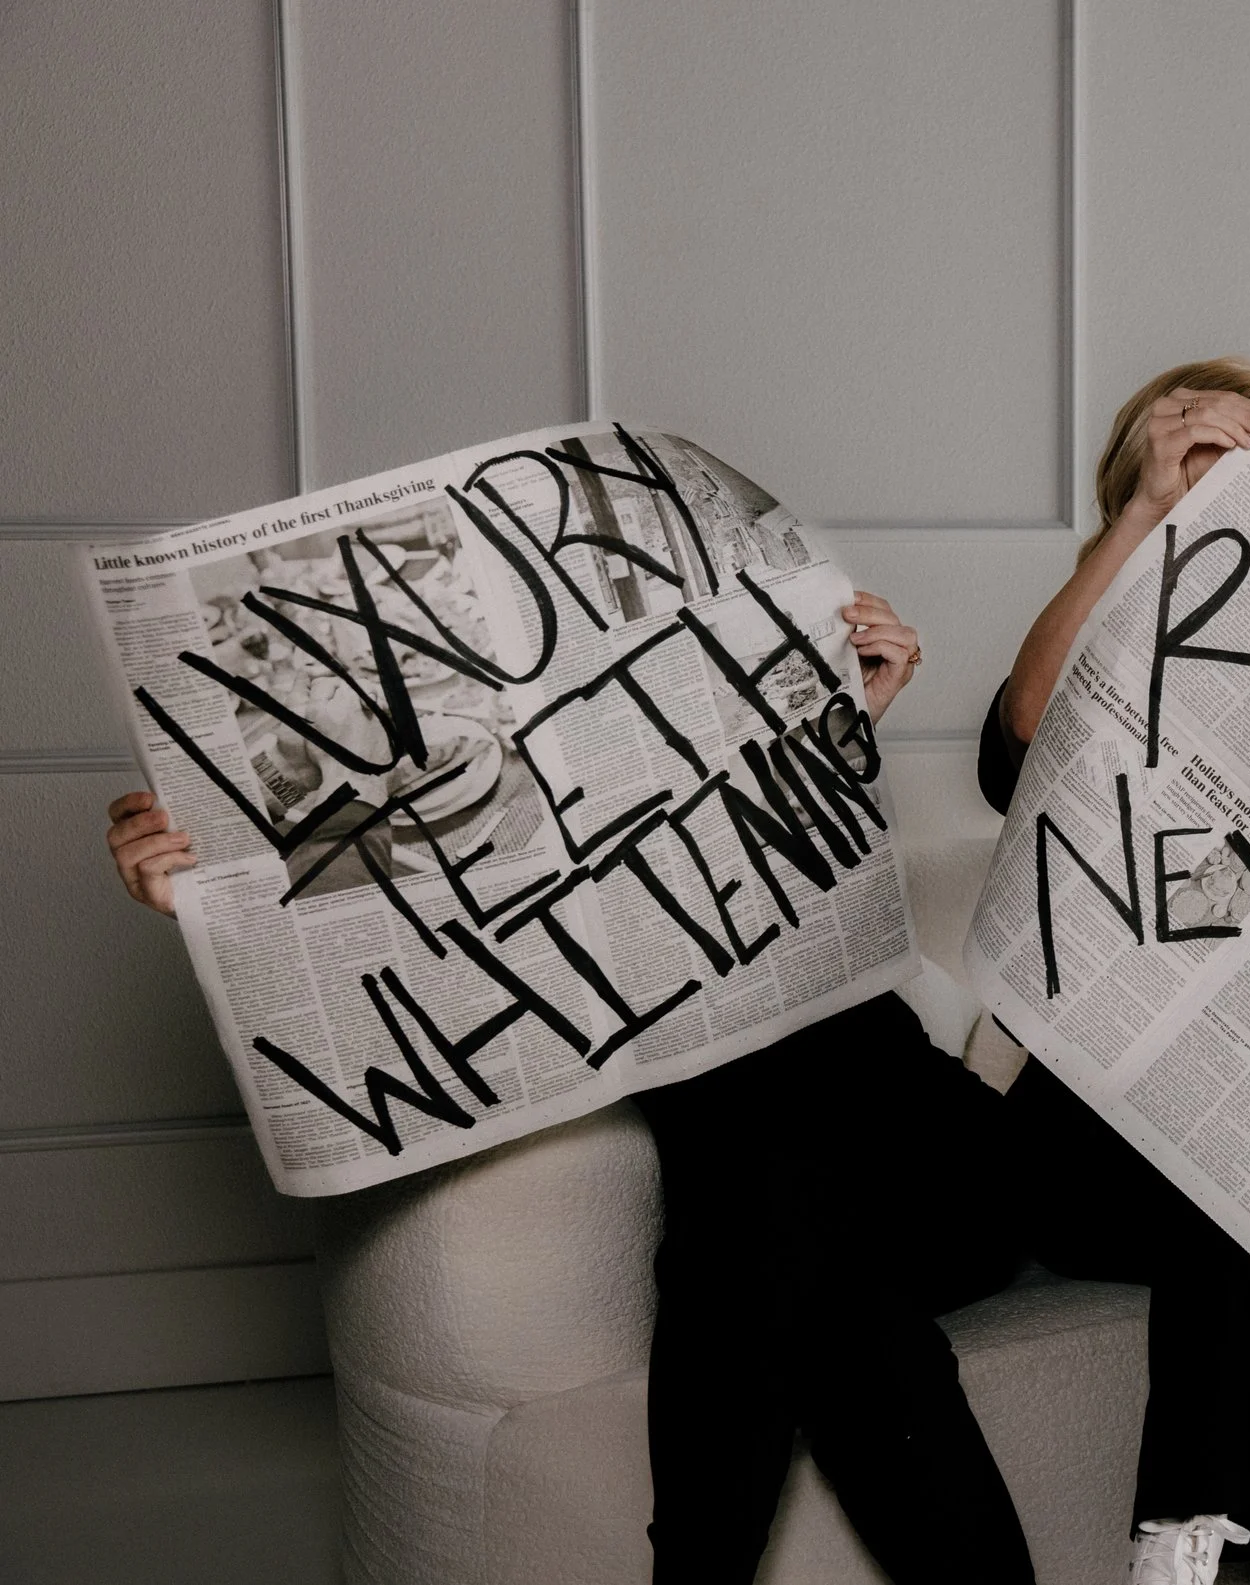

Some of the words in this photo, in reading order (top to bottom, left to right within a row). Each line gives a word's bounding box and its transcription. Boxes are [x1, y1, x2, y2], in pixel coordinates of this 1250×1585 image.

[93, 555, 131, 570] Little
[132, 548, 189, 567] known
[191, 533, 246, 555] history
[251, 522, 268, 539] of
[271, 518, 297, 533] the
[299, 508, 331, 525] first
[335, 479, 435, 515] Thanksgiving
[133, 421, 719, 860] LUXURY
[1071, 663, 1092, 694] speech,
[1077, 651, 1100, 682] There's
[1098, 680, 1106, 689] a
[1105, 685, 1125, 704] line
[1159, 736, 1179, 756] free
[279, 568, 842, 960] TEETH
[1189, 754, 1233, 799] Holidays
[1160, 789, 1171, 801] new
[1170, 799, 1186, 816] survey
[1165, 783, 1181, 799] tough
[1178, 795, 1196, 814] budget
[1170, 778, 1186, 792] SNAP
[1181, 791, 1206, 813] recipients
[1204, 810, 1216, 822] face
[1180, 766, 1206, 793] than
[1205, 788, 1233, 817] feast
[1231, 813, 1249, 832] for
[252, 692, 888, 1157] WHITENING
